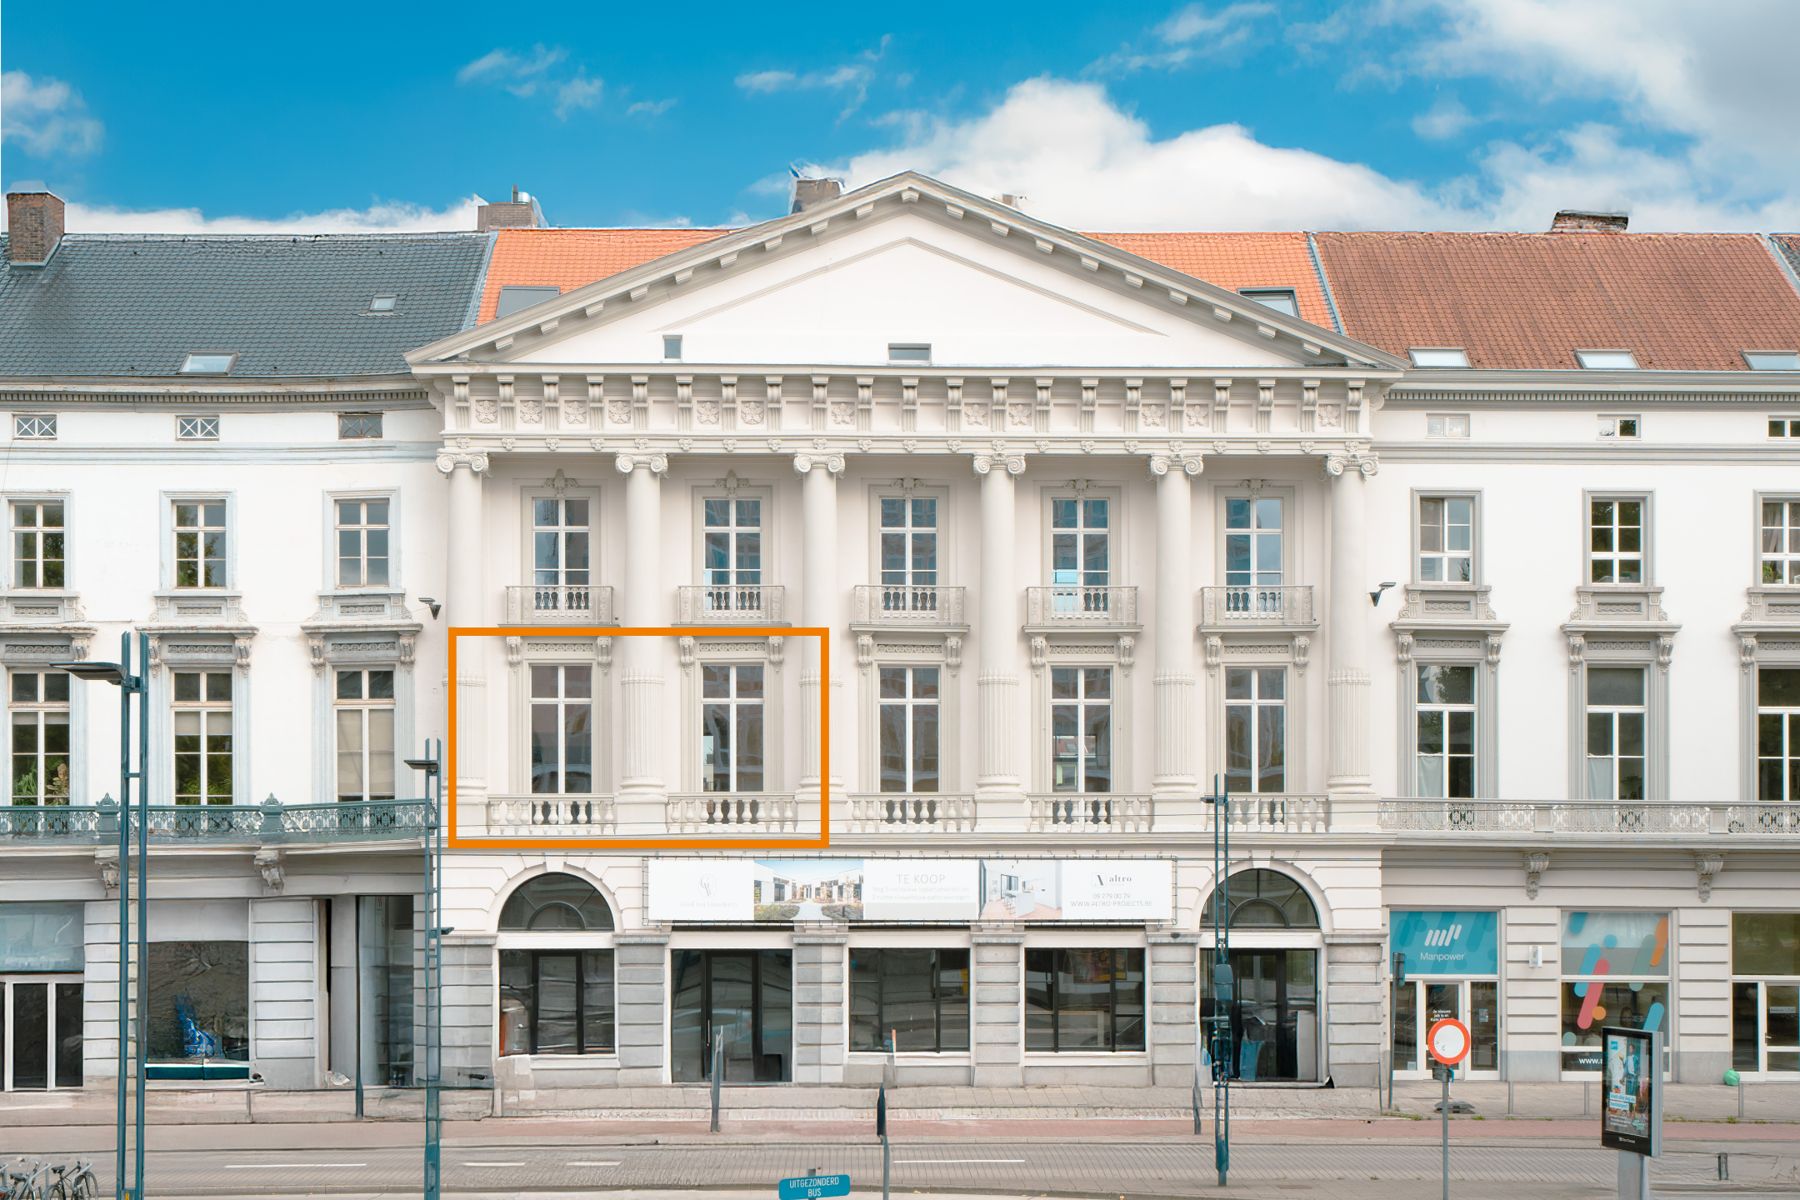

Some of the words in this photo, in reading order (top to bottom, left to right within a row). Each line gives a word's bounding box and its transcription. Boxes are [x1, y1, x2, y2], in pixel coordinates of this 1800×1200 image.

[896, 873, 910, 884] TE
[913, 873, 946, 884] KOOP
[1109, 874, 1132, 882] altro
[1420, 952, 1465, 962] Manpower
[789, 1177, 840, 1189] UITGEZONDERD
[807, 1188, 822, 1197] BUS
